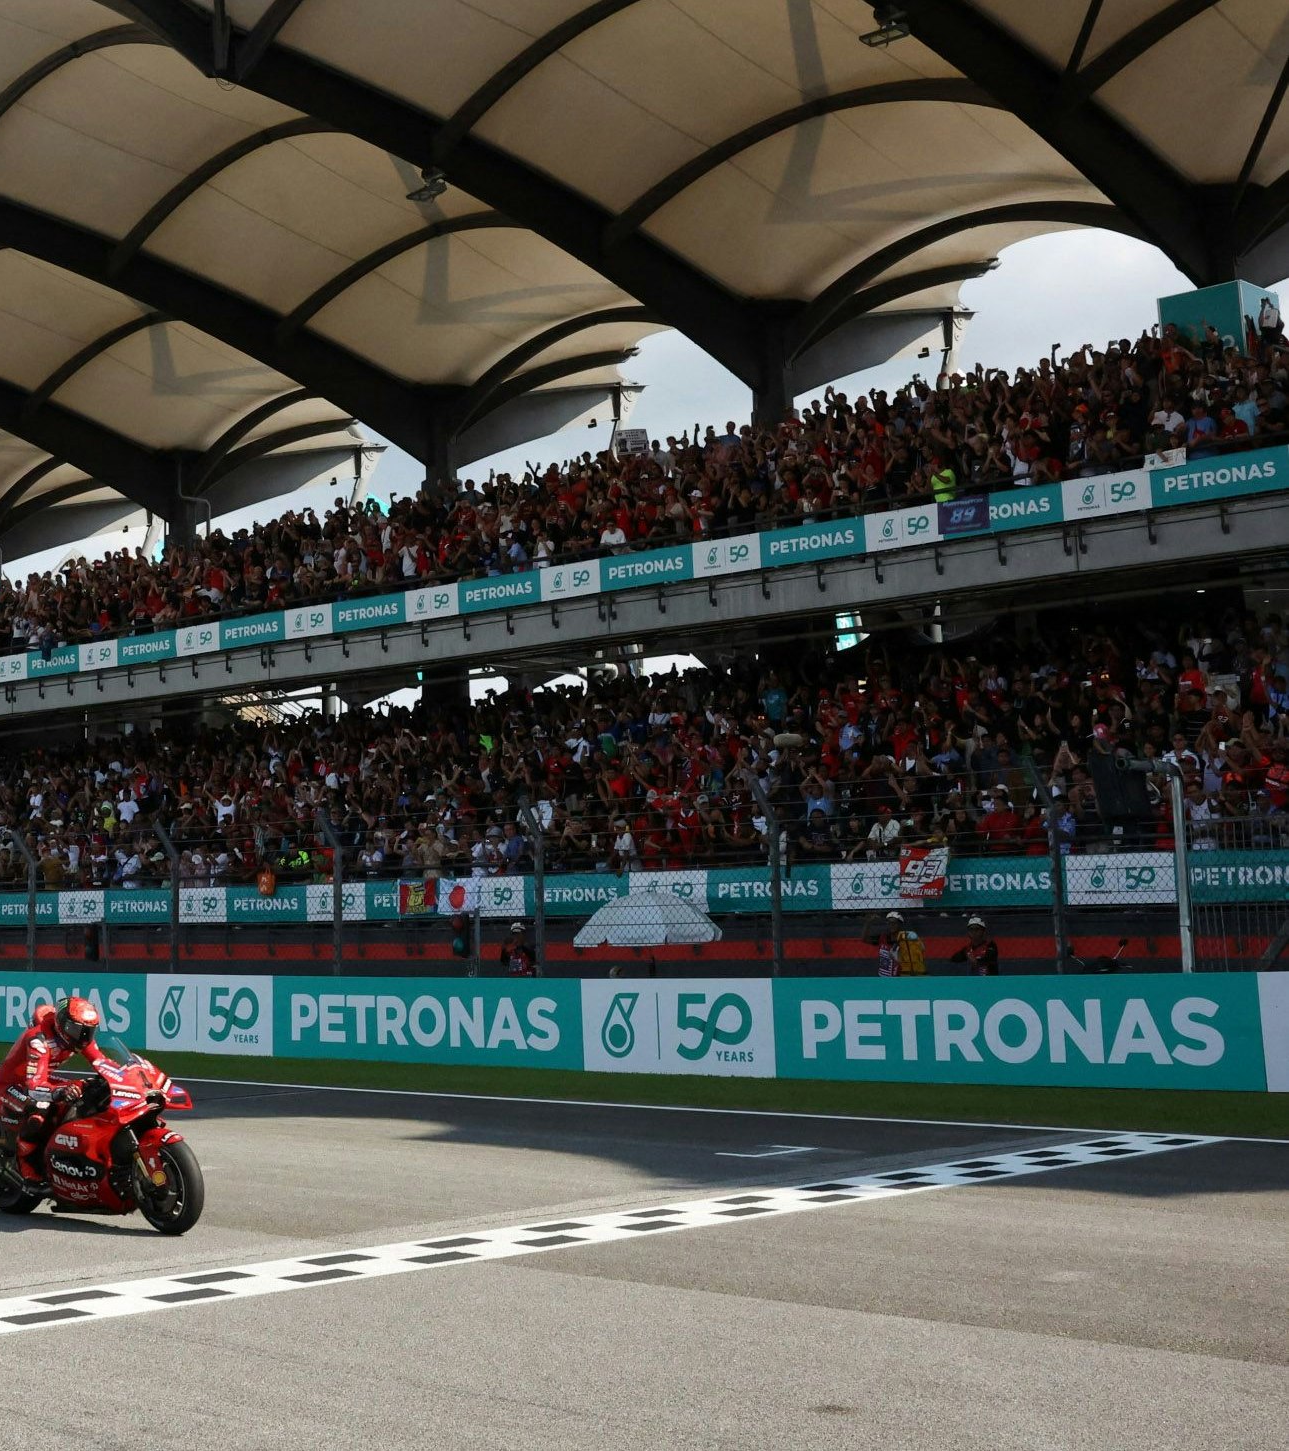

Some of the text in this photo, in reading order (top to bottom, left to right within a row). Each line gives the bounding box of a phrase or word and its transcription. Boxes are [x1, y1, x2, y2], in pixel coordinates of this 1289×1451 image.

[1164, 462, 1276, 492] PETRONAS
[1111, 481, 1135, 502] 50
[989, 498, 1050, 521] RONAS
[908, 516, 929, 535] 50
[770, 530, 854, 555] PETRONAS
[730, 545, 748, 563] 50
[609, 557, 683, 580] PETRONAS
[573, 570, 590, 587] 50
[434, 593, 449, 608] 50
[466, 581, 532, 603] PETRONAS
[310, 613, 324, 628] 50
[339, 602, 398, 622] PETRONAS
[200, 631, 212, 645] 50
[225, 622, 278, 640] PETRONAS
[100, 648, 111, 661] 50
[123, 640, 170, 656] PETRONAS
[32, 654, 75, 669] PETRONAS
[901, 860, 941, 883] 93
[1126, 867, 1155, 889] 50
[1191, 866, 1289, 886] PETRON
[234, 897, 297, 911] PETRONAS
[494, 887, 512, 905] 50
[534, 887, 617, 903] ETRONAS
[83, 900, 96, 915] 50
[111, 901, 167, 913] PETRONAS
[203, 897, 217, 912] 50
[209, 987, 259, 1042] 50
[291, 994, 559, 1052] PETRONAS
[677, 993, 752, 1061] 50
[801, 997, 1224, 1066] PETRONAS
[234, 1034, 259, 1044] YEARS
[716, 1050, 754, 1063] YEARS
[8, 1086, 27, 1102] Lenovo
[112, 1090, 141, 1099] Lenovo
[55, 1134, 78, 1149] GIVI
[51, 1155, 97, 1177] Lenovo
